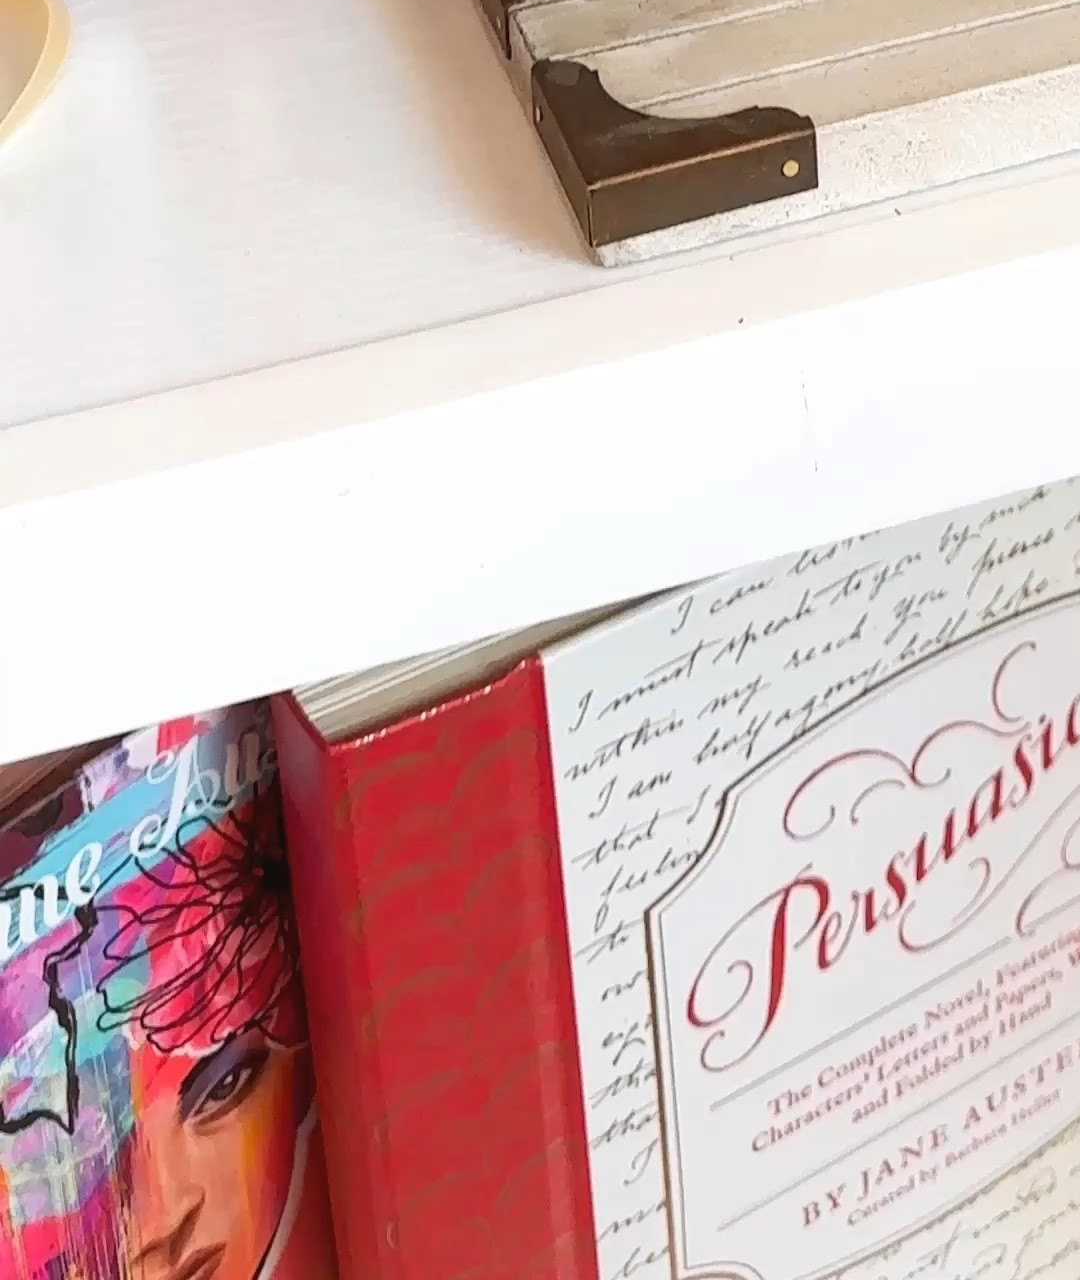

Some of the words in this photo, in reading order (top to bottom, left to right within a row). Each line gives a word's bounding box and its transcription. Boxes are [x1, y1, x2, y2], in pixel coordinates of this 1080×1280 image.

[767, 1082, 812, 1118] The
[817, 1019, 920, 1089] Complete
[851, 1089, 889, 1125] and
[894, 1044, 965, 1099] Folded
[968, 1032, 994, 1058] by
[997, 990, 1053, 1040] Hand
[953, 1003, 990, 1037] and
[802, 1180, 848, 1229] BY
[856, 1122, 951, 1203] JANE
